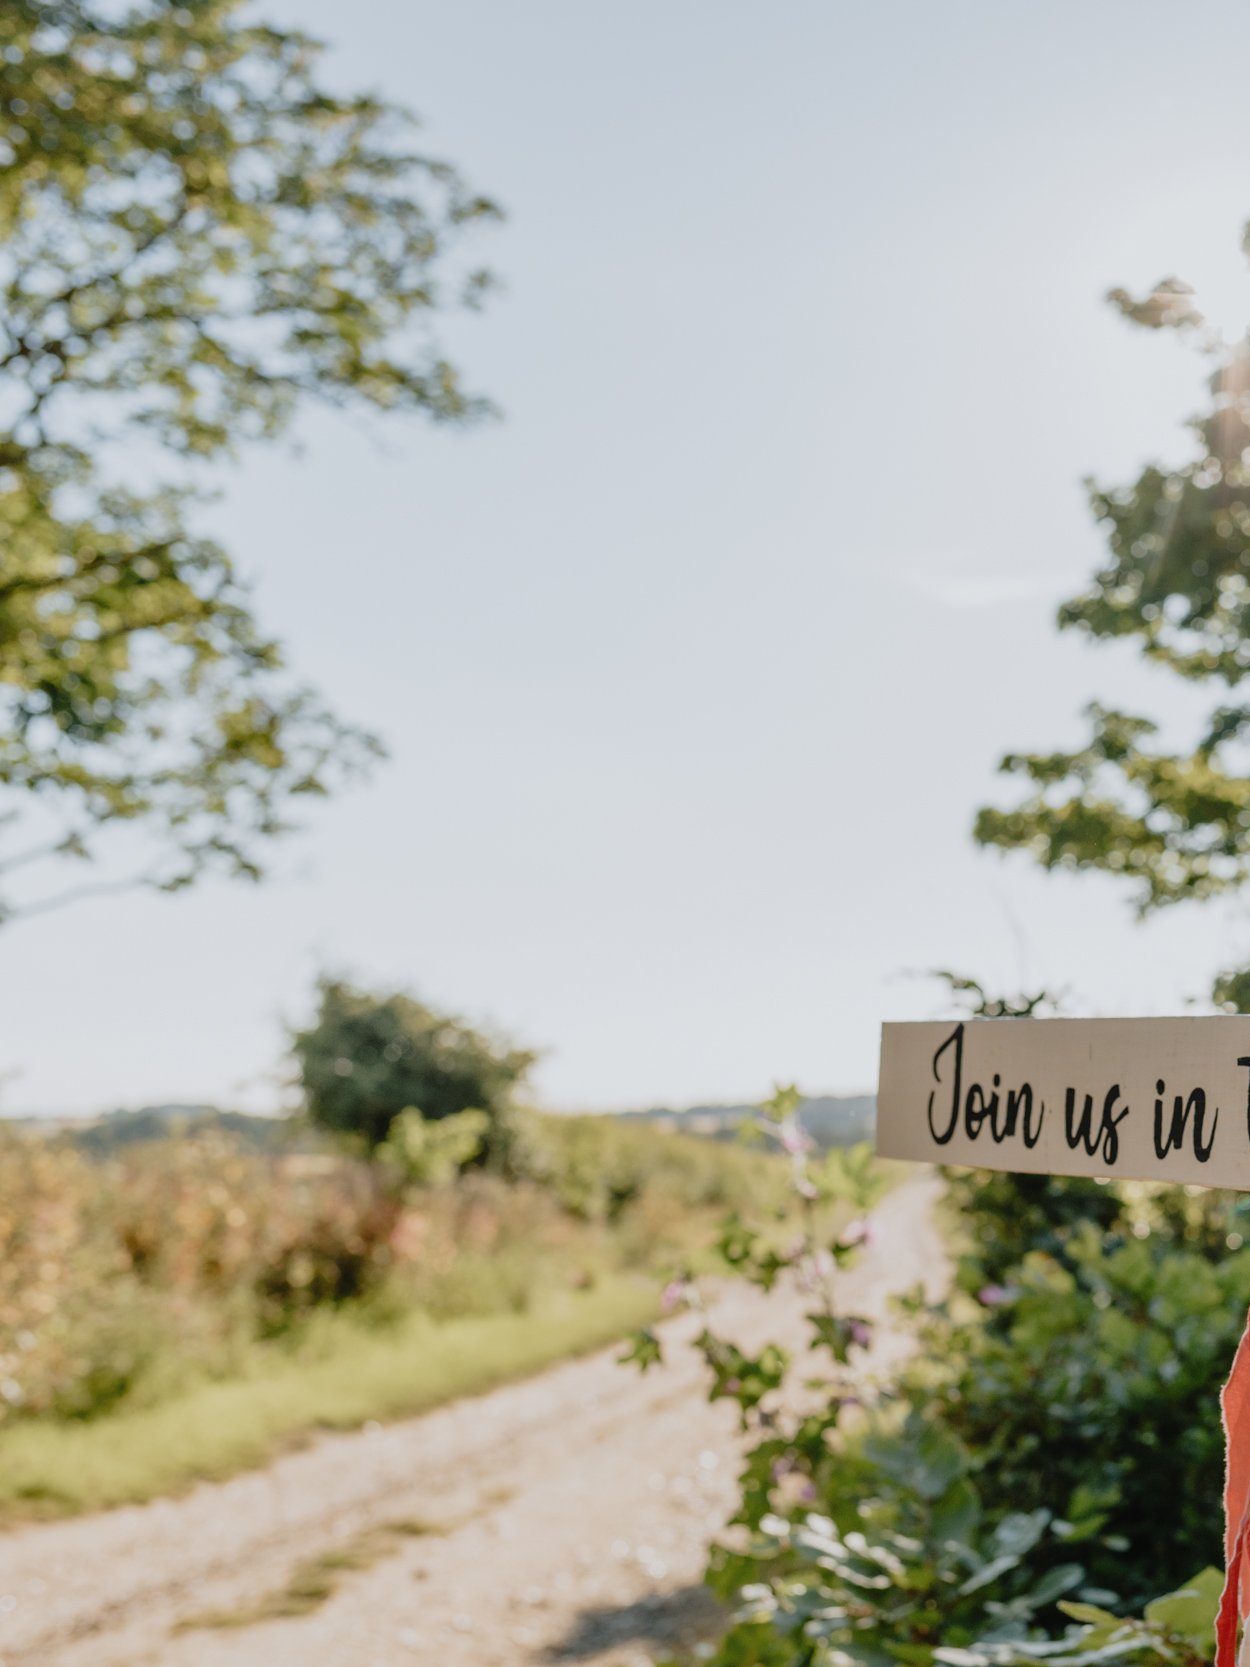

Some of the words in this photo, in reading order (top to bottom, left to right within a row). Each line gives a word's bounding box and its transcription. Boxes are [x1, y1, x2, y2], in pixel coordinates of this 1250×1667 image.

[927, 1023, 1045, 1150] Join
[1064, 1083, 1130, 1166] us
[1153, 1078, 1219, 1163] in
